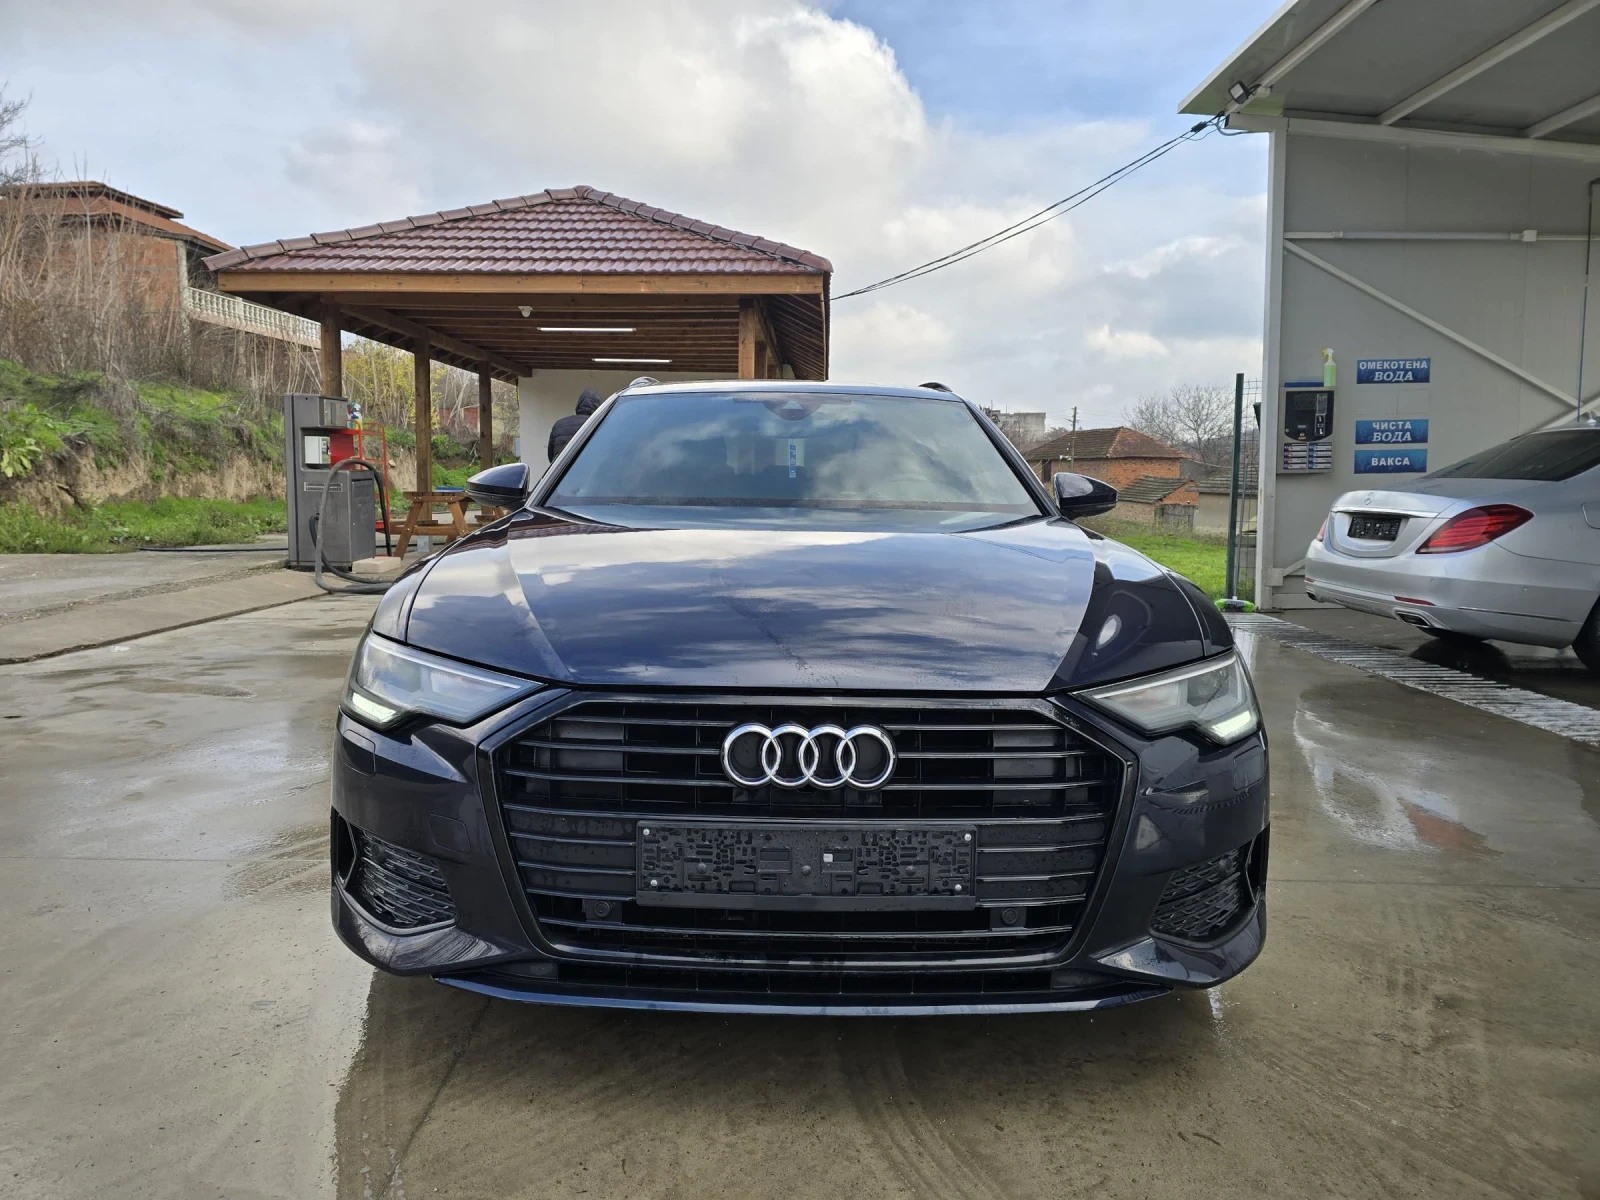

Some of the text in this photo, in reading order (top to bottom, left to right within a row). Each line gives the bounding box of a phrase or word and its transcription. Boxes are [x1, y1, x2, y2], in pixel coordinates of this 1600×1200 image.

[1359, 360, 1428, 370] ОМЕКОТЕНА
[1373, 371, 1413, 382] ВОДА
[1372, 421, 1412, 430] ЧИСТА
[1372, 431, 1412, 442] ВОДА
[1371, 457, 1410, 466] ВАКСА
